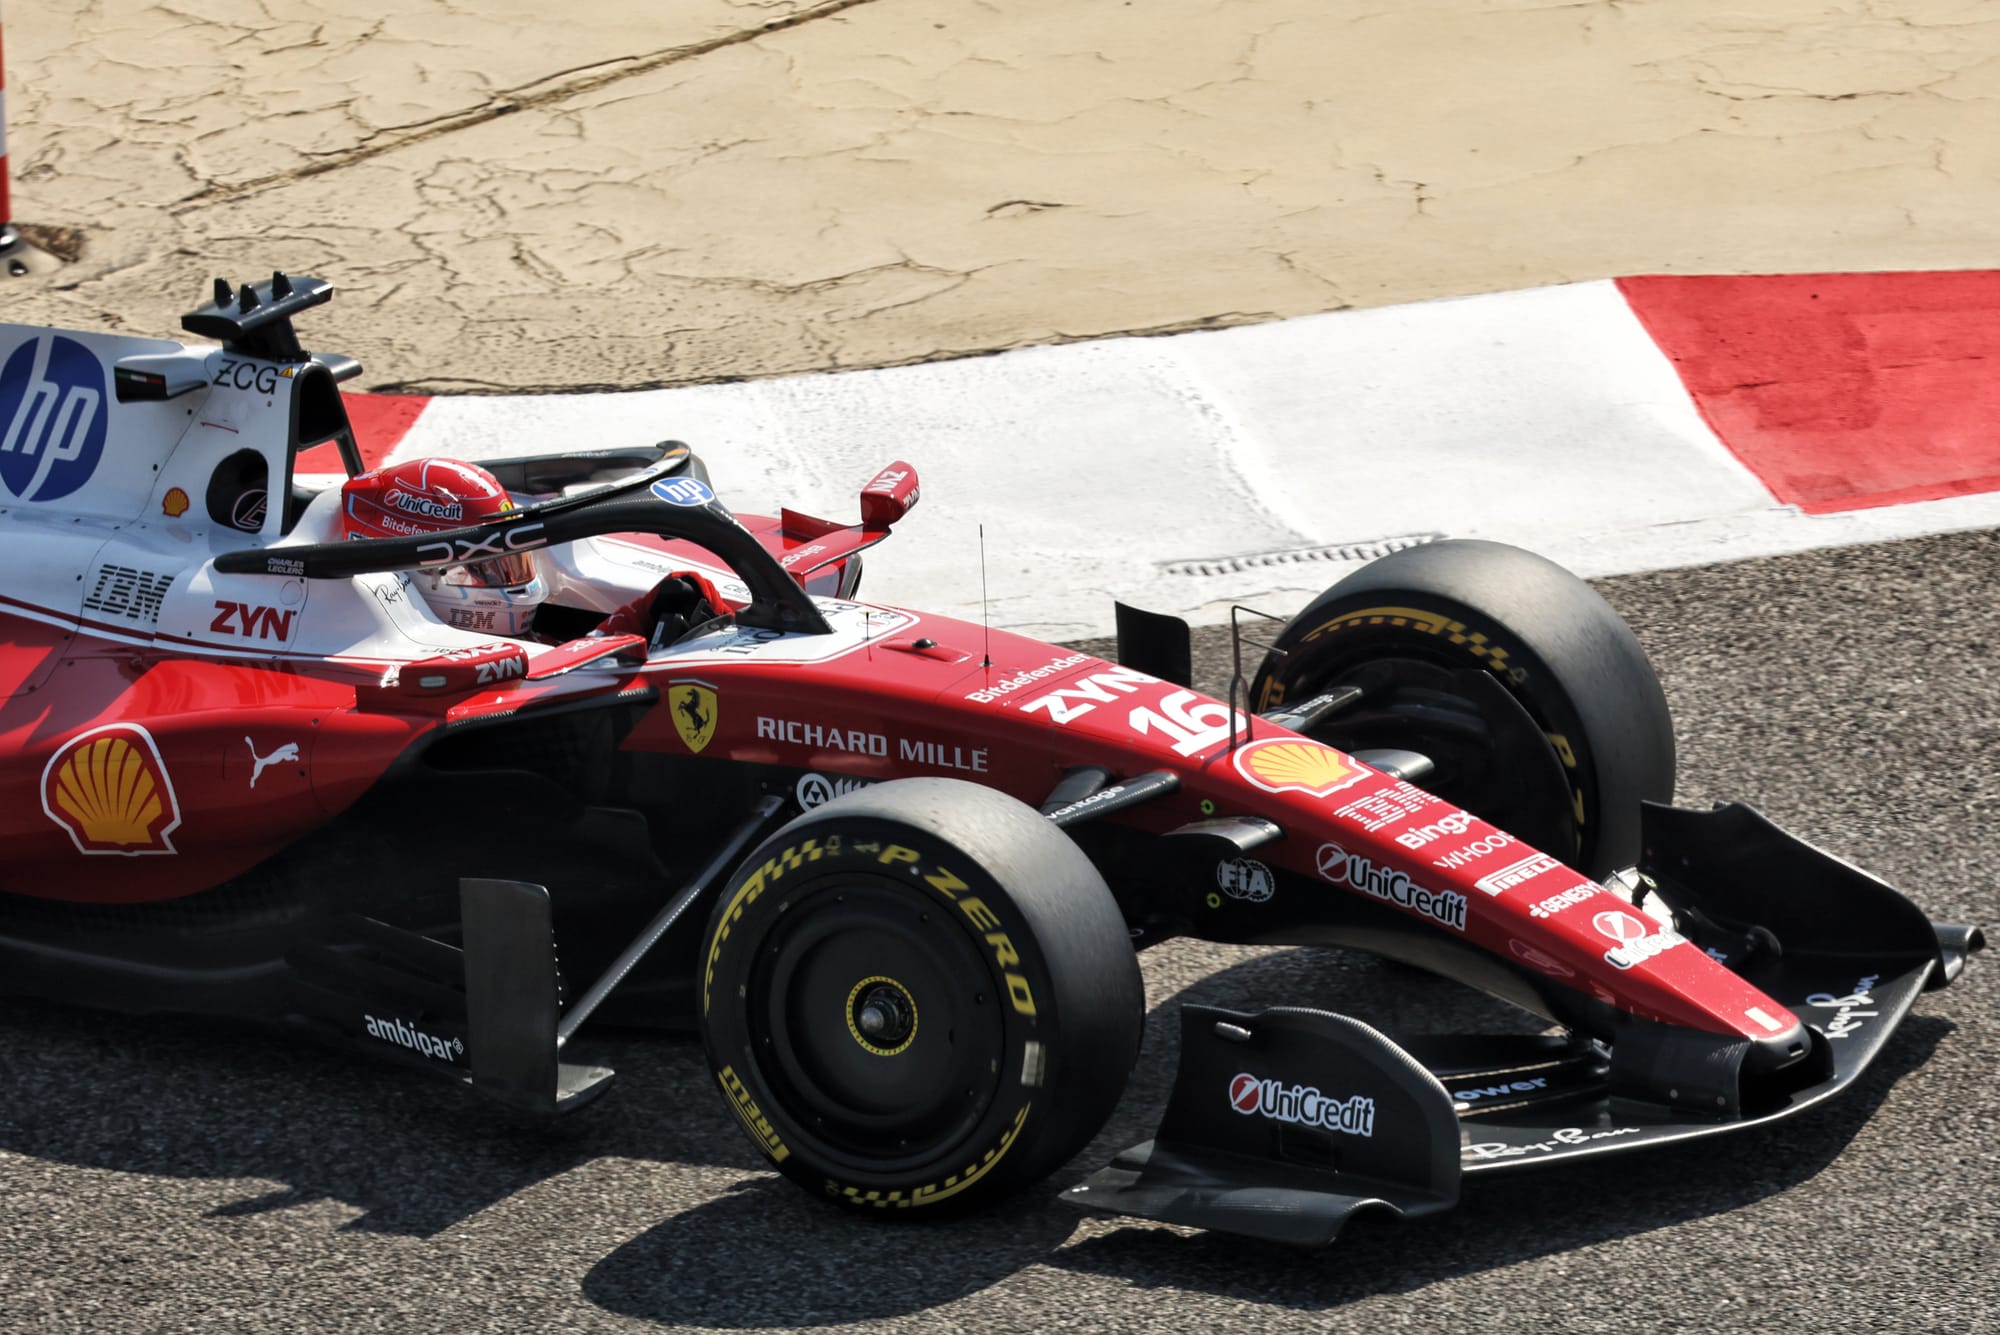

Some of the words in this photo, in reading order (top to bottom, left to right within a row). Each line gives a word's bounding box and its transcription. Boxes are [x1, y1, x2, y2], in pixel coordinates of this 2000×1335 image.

[1, 335, 100, 500] hp
[397, 492, 463, 520] UniCredit
[655, 479, 705, 504] hp
[267, 557, 304, 568] CHARLES
[416, 522, 547, 566] DXC
[84, 564, 175, 623] IBM
[448, 608, 496, 630] IBM
[210, 600, 292, 642] ZYN
[475, 656, 523, 684] ZYN
[965, 652, 1092, 704] Bitdefender
[1020, 666, 1163, 725] ZYN
[757, 716, 888, 756] RICHARD
[900, 738, 988, 773] MILLE
[1128, 689, 1247, 757] 16
[1333, 781, 1444, 832] IBM
[1395, 810, 1480, 850] BingX
[1348, 856, 1466, 932] UniCredit
[924, 866, 1037, 1016] ZERO
[718, 1064, 790, 1162] PIRELLI
[1259, 1079, 1376, 1137] UniCredit
[1454, 1077, 1548, 1100] ower
[1460, 1127, 1641, 1159] Ray-Ban
